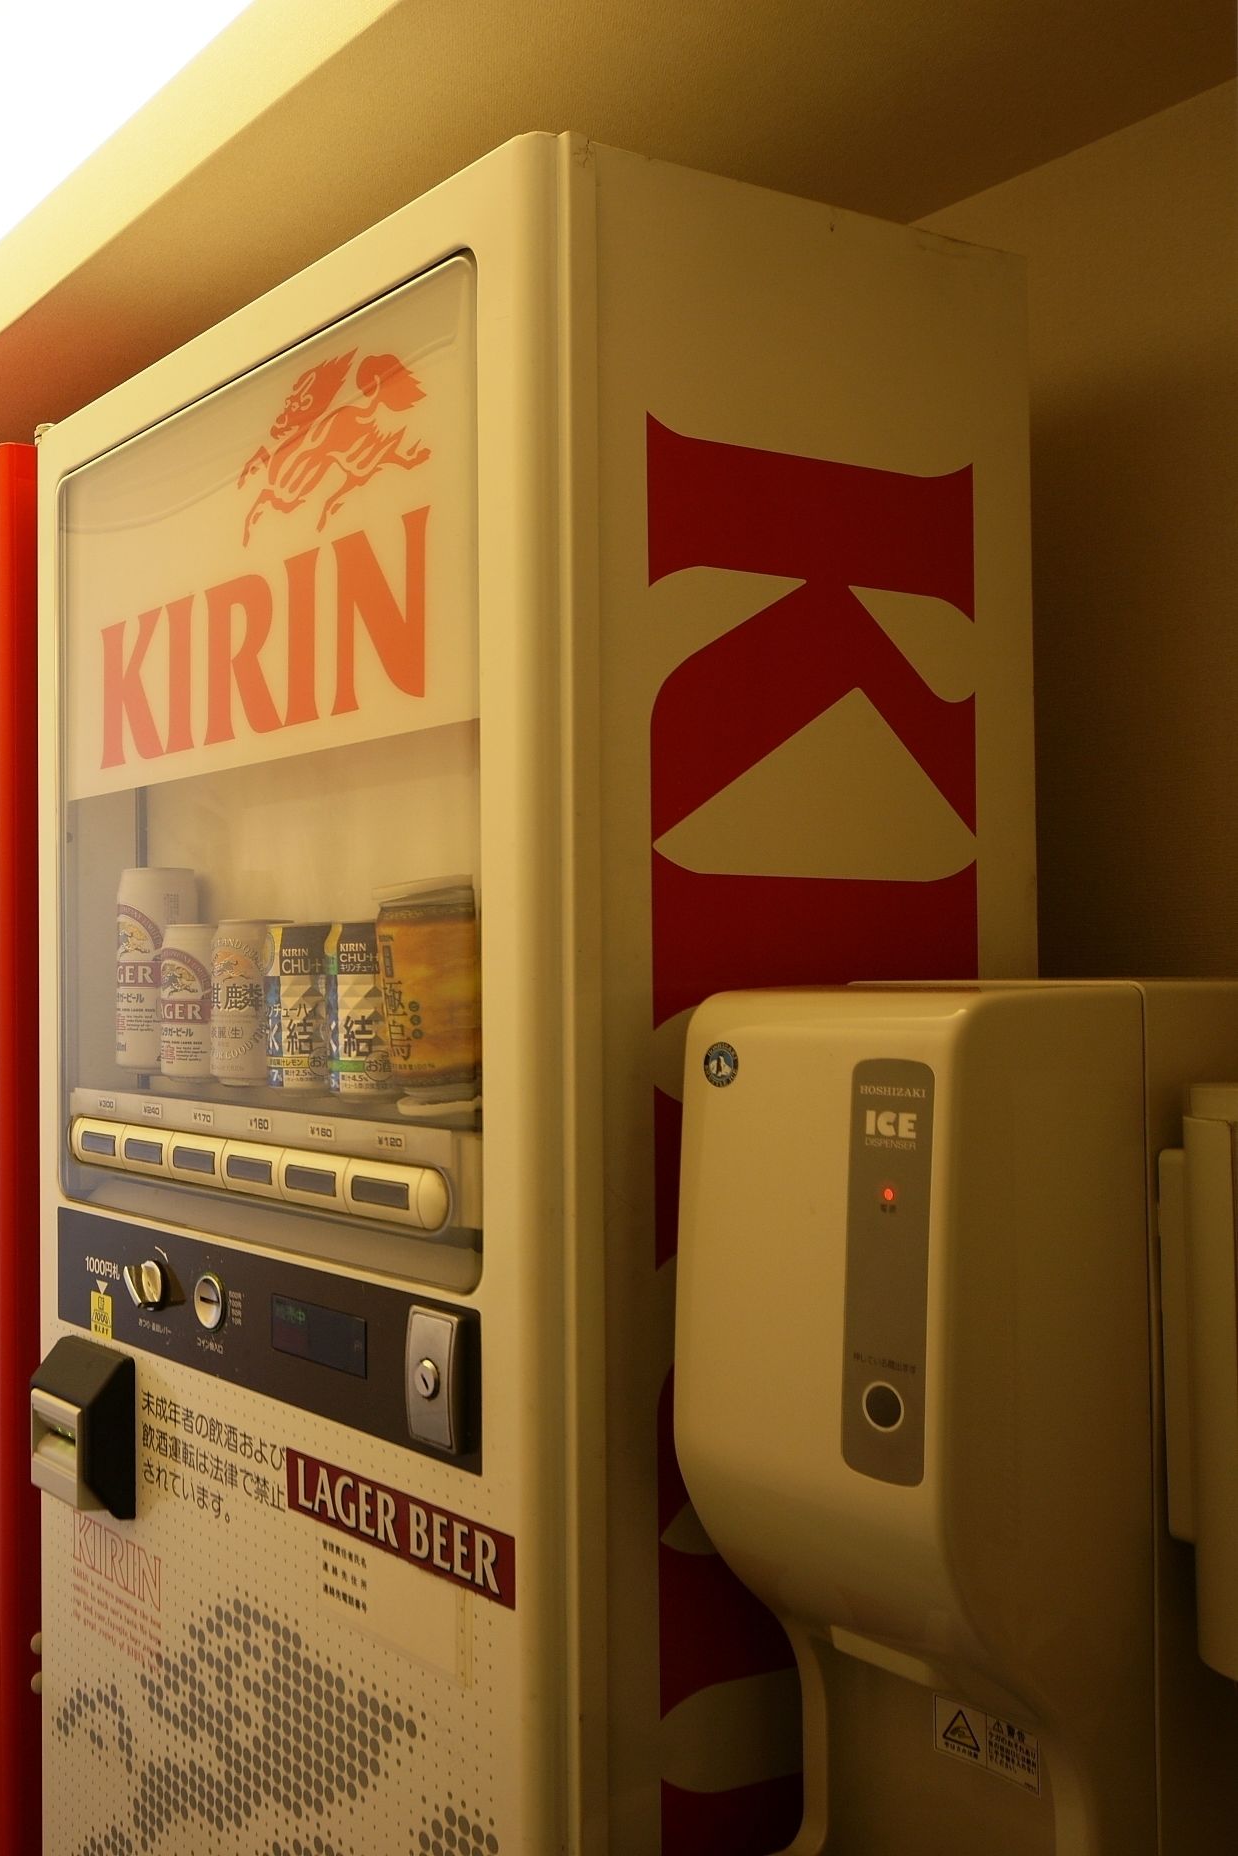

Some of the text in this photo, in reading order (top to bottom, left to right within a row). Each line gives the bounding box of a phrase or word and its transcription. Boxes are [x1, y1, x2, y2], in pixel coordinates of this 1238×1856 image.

[100, 505, 431, 769] KIRIN
[282, 948, 308, 957] KIRIN
[340, 943, 366, 952] KIRIN
[860, 1085, 926, 1099] HOSHIZAKI
[193, 1112, 211, 1124] ¥170
[866, 1110, 917, 1139] ICE
[865, 1137, 917, 1151] DISPENSER
[85, 1255, 120, 1281] 1000円札
[142, 1391, 286, 1471] 未成年者の飲酒および
[142, 1423, 286, 1512] 飲酒運転は法律で禁止
[143, 1461, 231, 1524] されています。
[297, 1458, 500, 1595] LAGER BEER
[73, 1511, 161, 1612] KIRIN
